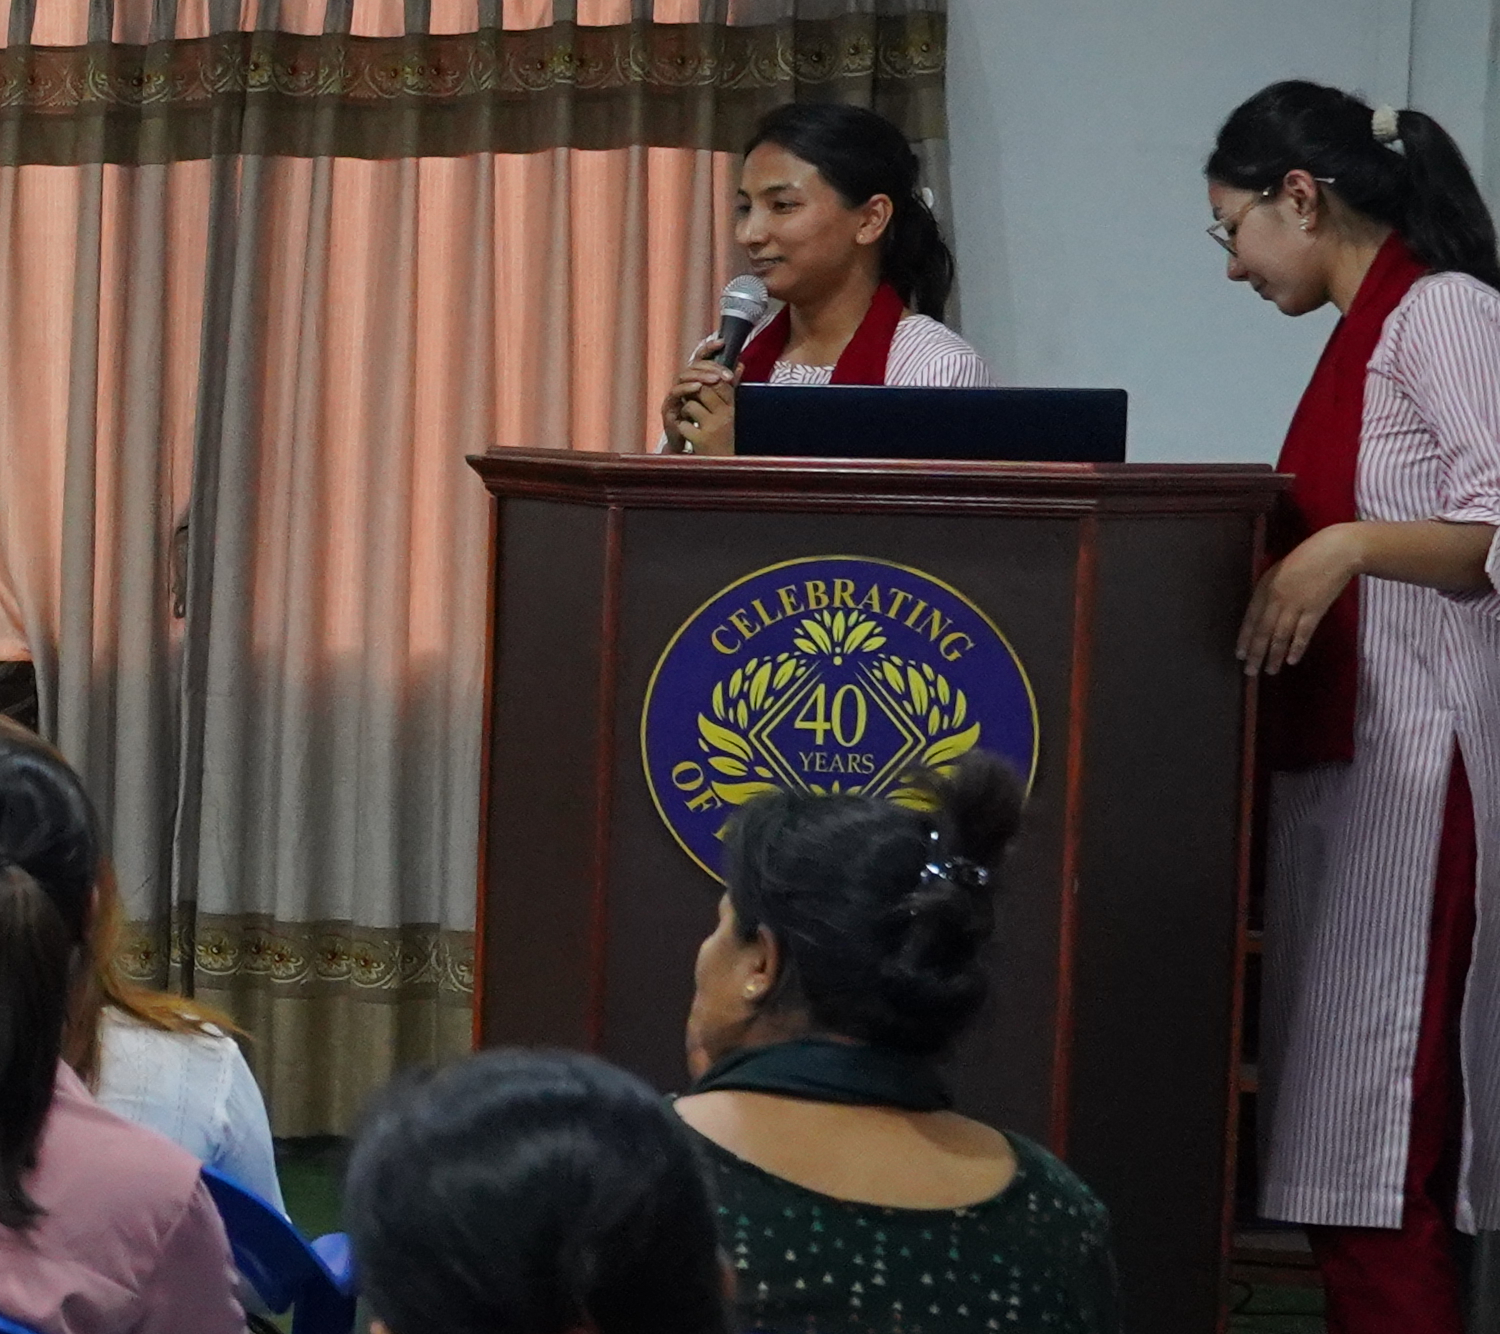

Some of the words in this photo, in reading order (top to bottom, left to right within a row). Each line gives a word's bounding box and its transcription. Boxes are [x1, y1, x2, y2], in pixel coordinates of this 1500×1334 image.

[710, 578, 976, 663] CELEBRATING
[794, 682, 868, 748] 40
[671, 760, 723, 814] OF
[798, 751, 876, 775] YEARS
